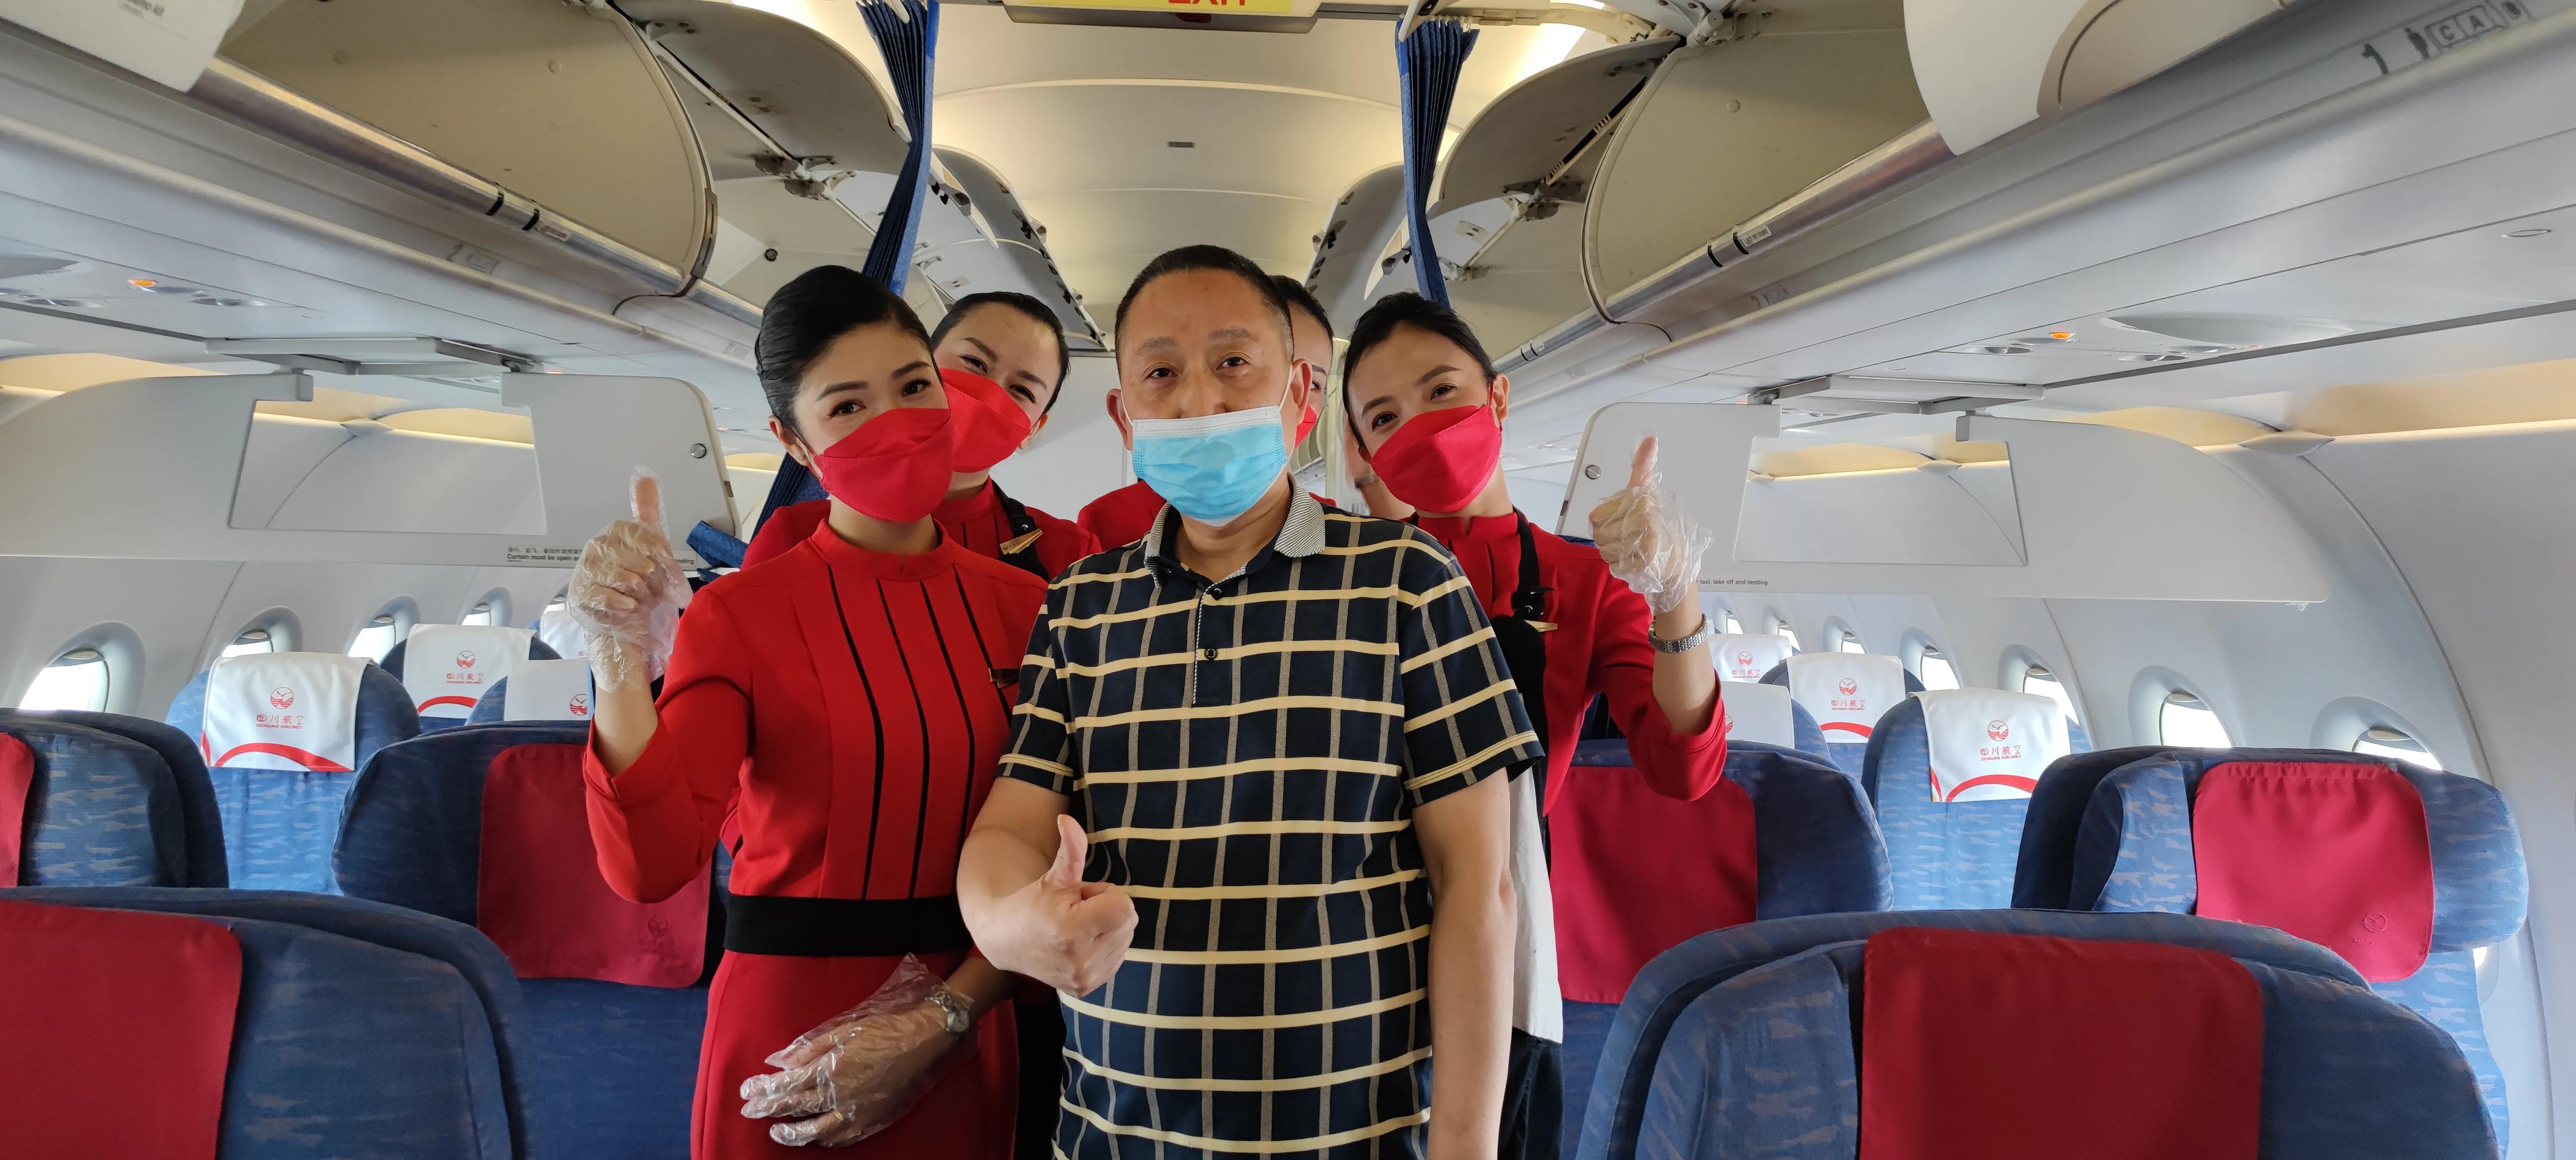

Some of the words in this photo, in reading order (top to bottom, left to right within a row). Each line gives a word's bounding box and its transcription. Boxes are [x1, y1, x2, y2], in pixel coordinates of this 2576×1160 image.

[2361, 43, 2389, 75] 1
[2439, 25, 2455, 41] C
[2469, 14, 2485, 31] A
[1980, 745, 2021, 755] 四川航空
